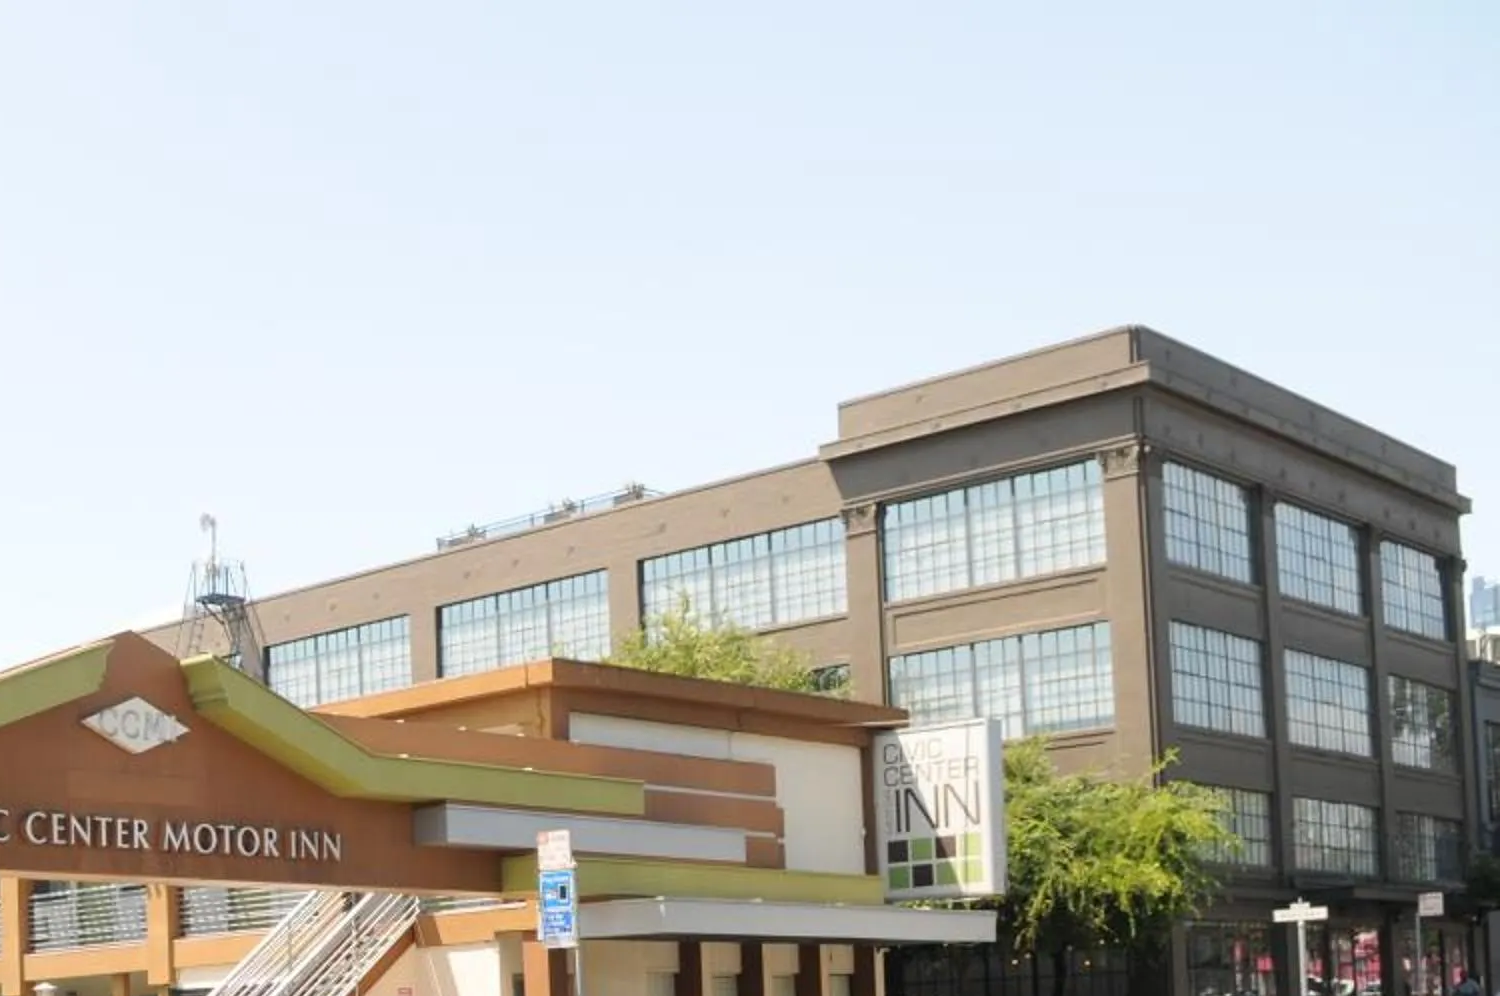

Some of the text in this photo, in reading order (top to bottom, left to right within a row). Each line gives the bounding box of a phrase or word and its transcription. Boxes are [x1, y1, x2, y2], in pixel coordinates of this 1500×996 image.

[884, 738, 942, 764] CIVIC
[884, 755, 980, 787] CENTER
[895, 780, 980, 833] INN
[24, 811, 151, 850] CENTER
[162, 821, 280, 859] MOTOR
[290, 831, 343, 861] INN
